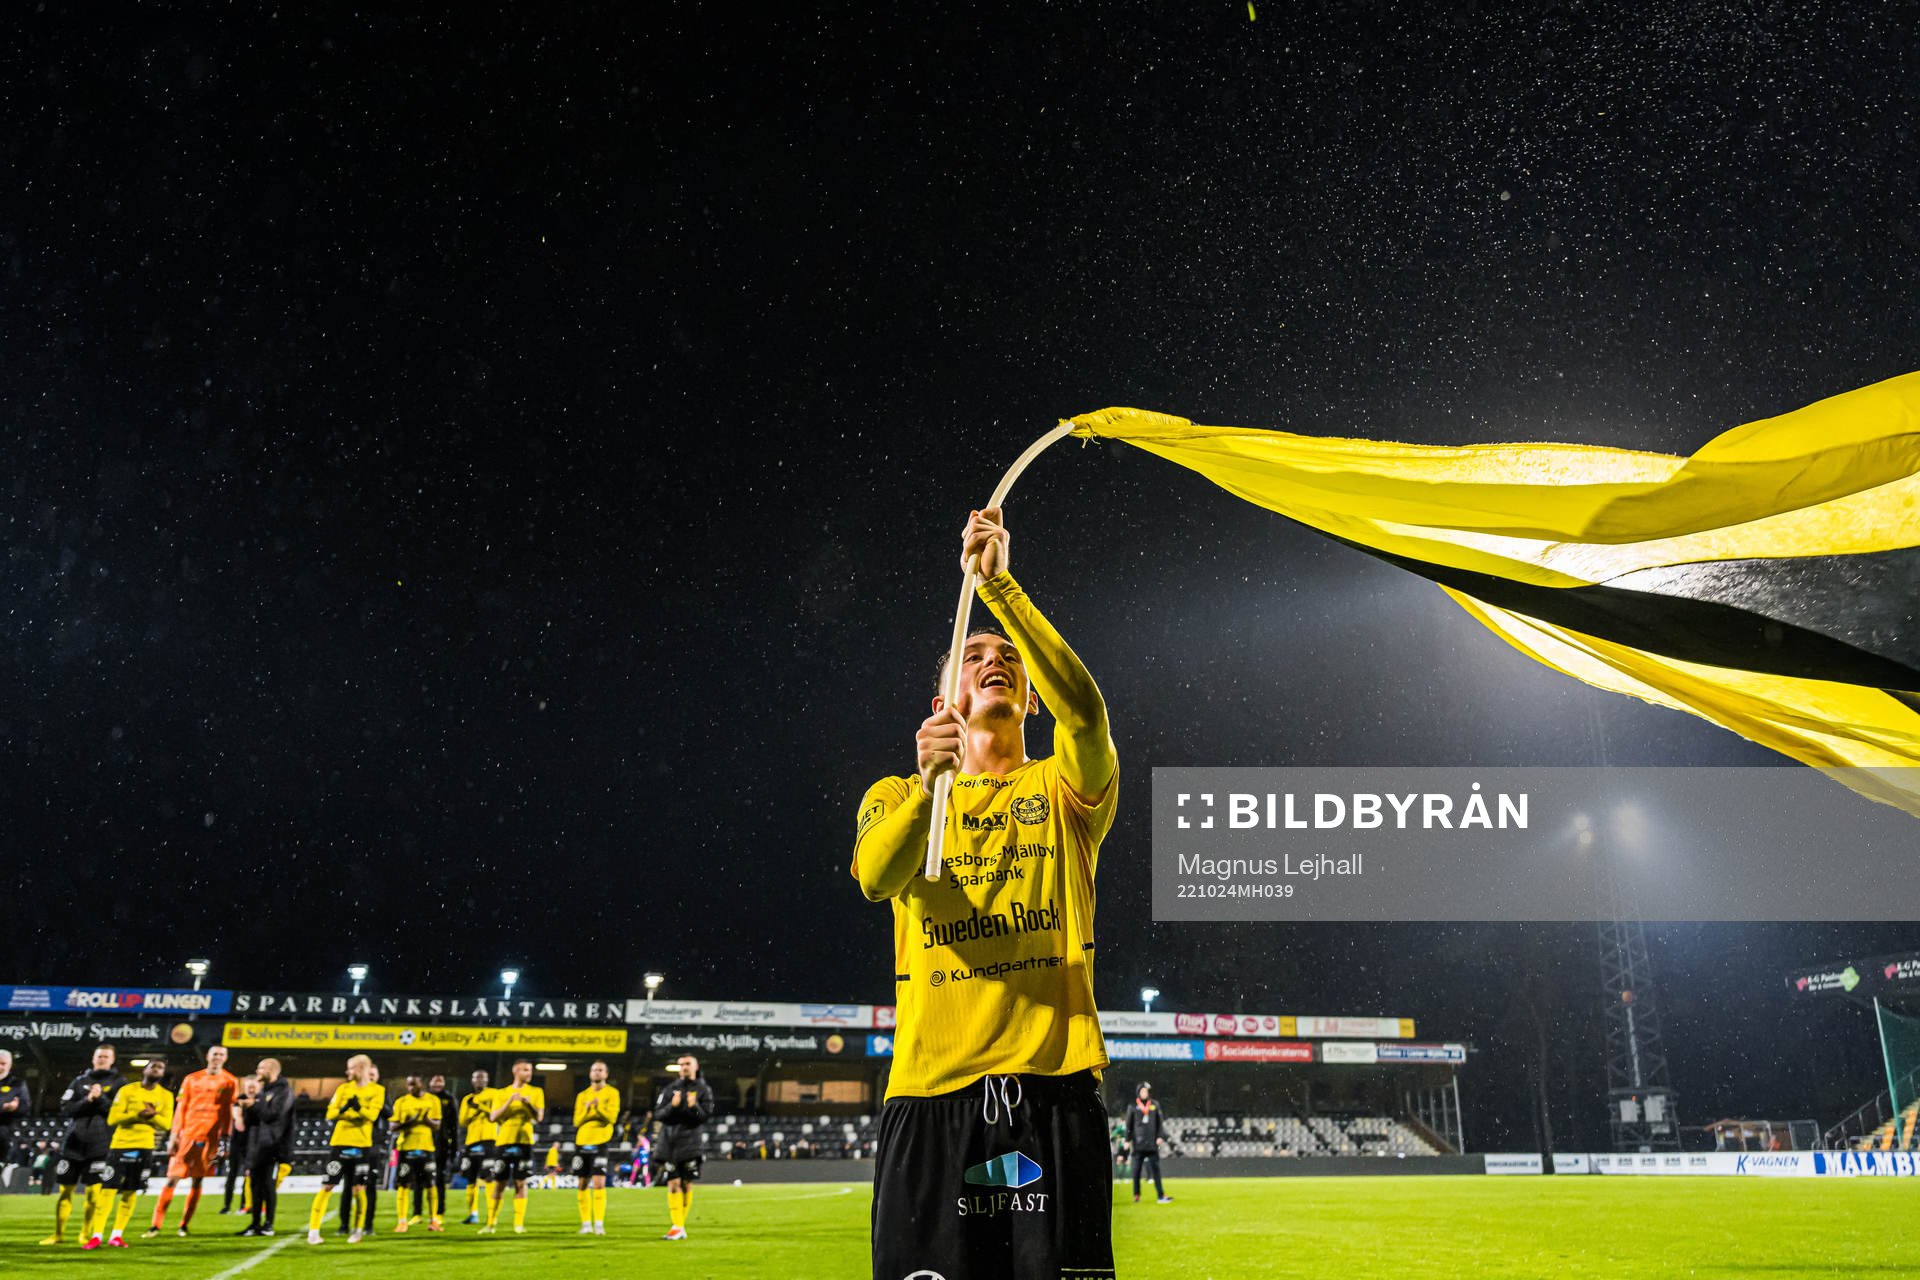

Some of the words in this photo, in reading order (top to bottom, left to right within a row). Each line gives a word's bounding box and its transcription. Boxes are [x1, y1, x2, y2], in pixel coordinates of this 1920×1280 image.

[950, 865, 1025, 890] Sparbank
[921, 907, 1009, 950] Sweden
[1010, 898, 1062, 934] Rock
[951, 956, 1065, 982] Kundpartner
[235, 994, 626, 1020] SPARBANKSLÄKTAREN
[89, 1022, 159, 1042] Sparbank
[420, 1030, 472, 1046] Mjällby
[518, 1032, 602, 1049] hemmaplan
[763, 1034, 818, 1051] Sparbank
[1222, 1044, 1310, 1058] Socialdemokraterna
[1825, 1152, 1920, 1176] MALMB
